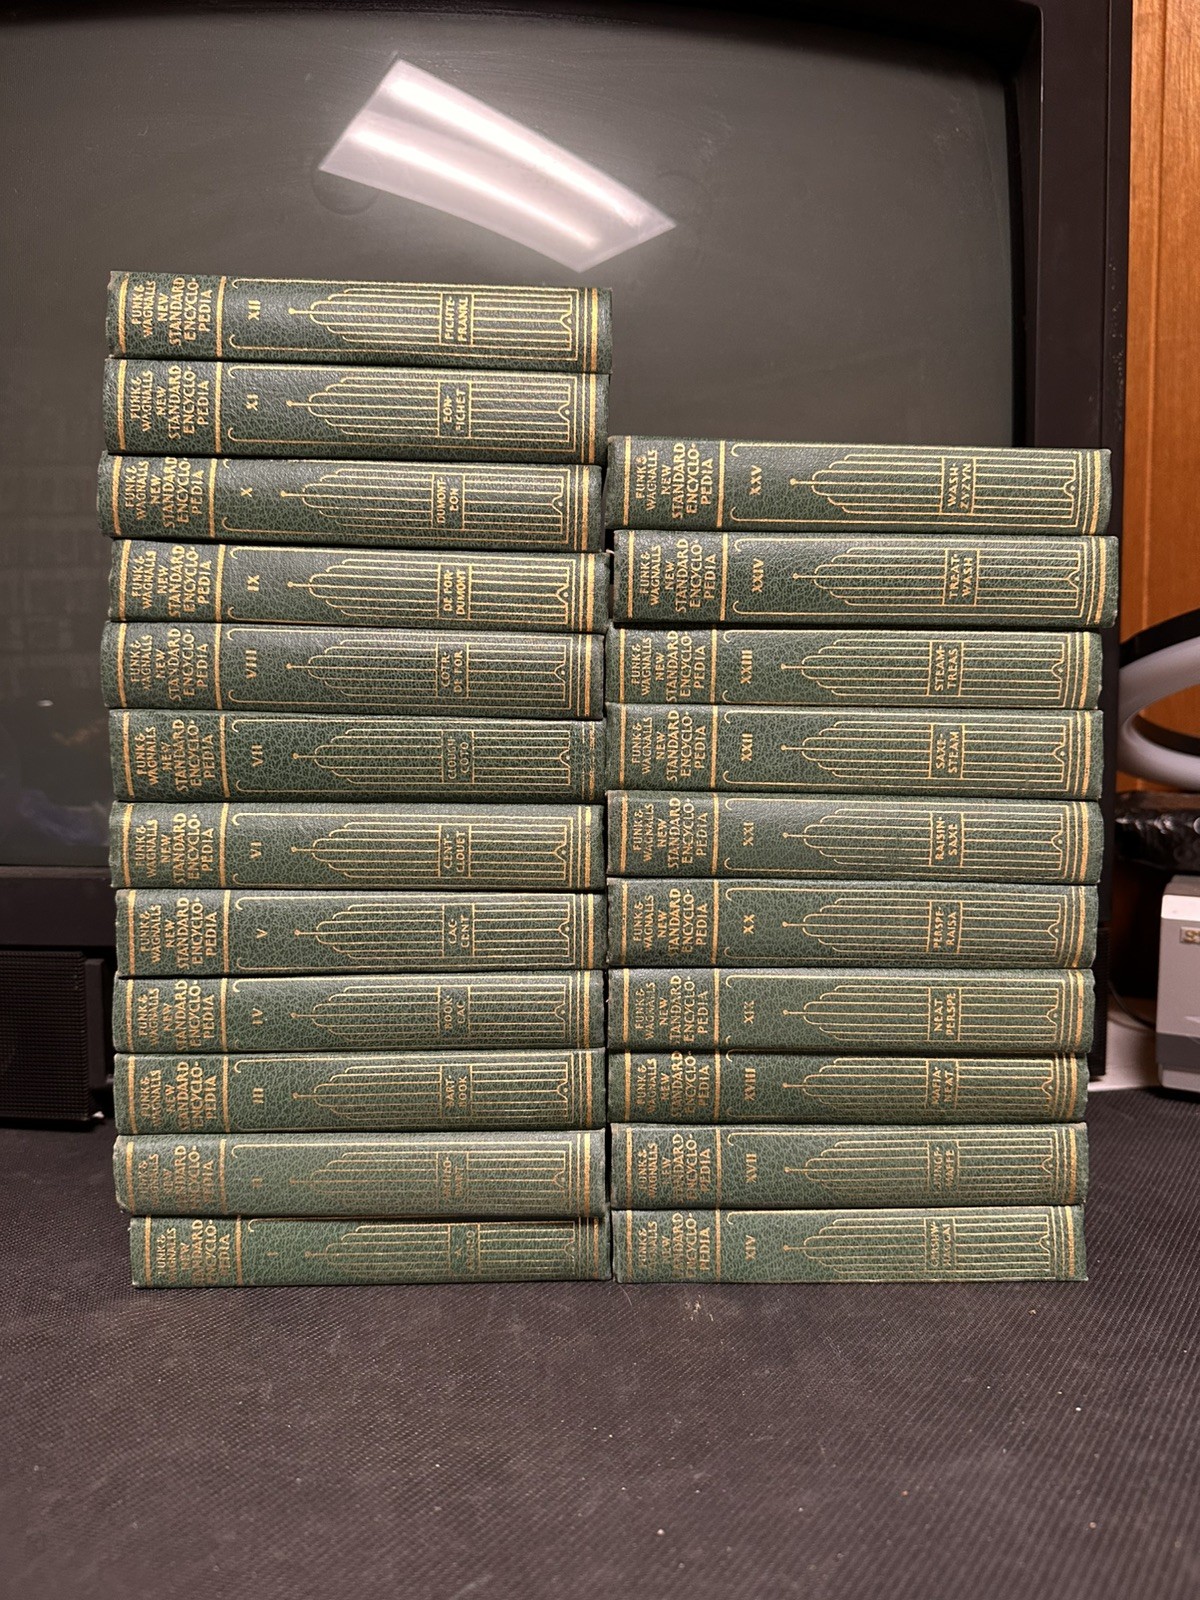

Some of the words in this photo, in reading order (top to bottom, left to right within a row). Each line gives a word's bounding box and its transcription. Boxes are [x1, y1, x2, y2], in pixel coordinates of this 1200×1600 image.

[132, 293, 144, 324] FUNK
[143, 281, 156, 337] WAGNALLS
[158, 293, 169, 321] NEW
[170, 278, 185, 346] STANDARD
[199, 290, 212, 332] PEDIA
[248, 300, 260, 320] XII
[130, 386, 141, 419] FUNK
[142, 370, 153, 432] WAGNALLS
[157, 386, 166, 415] NEW
[169, 365, 181, 439] STANDARD
[197, 380, 209, 425] PEDIA
[245, 394, 258, 411] XI
[125, 475, 137, 507] FUNK
[136, 461, 149, 520] WAGNALLS
[151, 475, 161, 504] NEW
[163, 457, 177, 528] STANDARD
[191, 470, 204, 514] PEDIA
[240, 488, 252, 497] X
[635, 465, 646, 499] FUNK
[646, 450, 658, 510] WAGNALLS
[661, 464, 671, 495] NEW
[672, 443, 686, 519] STANDARD
[701, 458, 713, 505] PEDIA
[749, 465, 762, 495] XXV
[948, 463, 958, 507] WASH-
[437, 477, 446, 524] DUMONT-
[132, 566, 143, 597] FUNK
[143, 551, 156, 609] WAGNALLS
[158, 565, 168, 594] NEW
[169, 546, 185, 617] STANDARD
[198, 560, 211, 604] PEDIA
[247, 575, 259, 591] IX
[456, 570, 466, 615] DUMONT
[640, 559, 650, 594] FUNK
[651, 544, 661, 606] WAGNALLS
[665, 561, 675, 590] NEW
[676, 538, 689, 613] STANDARD
[704, 554, 716, 599] PEDIA
[751, 558, 764, 593] XXIV
[949, 553, 959, 599] TREAT-
[962, 558, 972, 597] WASH
[246, 650, 257, 679] VIII
[631, 654, 640, 684] FUNK
[642, 638, 651, 695] WAGNALLS
[656, 652, 664, 680] NEW
[666, 631, 678, 702] STANDARD
[694, 646, 705, 688] PEDIA
[740, 649, 752, 684] XXIII
[935, 646, 945, 691] STEAM-
[947, 648, 958, 689] TREAS
[252, 745, 263, 767] VII
[460, 742, 469, 773] COTO
[632, 732, 641, 763] FUNK
[642, 717, 652, 774] WAGNALLS
[656, 732, 665, 759] NEW
[667, 710, 679, 781] STANDARD
[694, 726, 706, 769] PEDIA
[741, 733, 752, 761] XXII
[935, 733, 946, 770] SAXE-
[948, 731, 959, 773] STEAM
[147, 819, 158, 877] WAGNALLS
[161, 834, 171, 863] NEW
[173, 813, 187, 885] STANDARD
[202, 828, 214, 871] PEDIA
[250, 841, 261, 858] VI
[633, 818, 643, 850] FUNK
[644, 803, 654, 861] WAGNALLS
[658, 819, 667, 847] NEW
[668, 798, 680, 869] STANDARD
[696, 813, 708, 856] PEDIA
[743, 822, 754, 847] XXI
[935, 817, 945, 860] RAISIN-
[948, 823, 957, 856] SAXE
[136, 834, 146, 867] FUNK
[443, 834, 453, 869] CENT-
[456, 831, 466, 873] CLOUET
[140, 920, 150, 952] FUNK
[152, 905, 161, 963] WAGNALLS
[166, 920, 175, 948] NEW
[177, 897, 189, 969] STANDARD
[205, 912, 217, 956] PEDIA
[448, 918, 458, 944] CAC-
[461, 914, 470, 948] CENT
[743, 914, 755, 935] XX
[933, 907, 944, 949] PERSPE-
[946, 912, 956, 946] RAISA
[252, 1008, 263, 1024] IV
[444, 995, 453, 1029] BOOK-
[635, 999, 644, 1028] FUNK
[646, 983, 655, 1040] WAGNALLS
[660, 998, 668, 1026] NEW
[698, 991, 708, 1033] PEDIA
[744, 1000, 754, 1024] XIX
[934, 998, 943, 1031] NEAT
[946, 993, 956, 1036] PERSPE
[253, 1088, 263, 1104] III
[944, 1070, 953, 1102] NEAT
